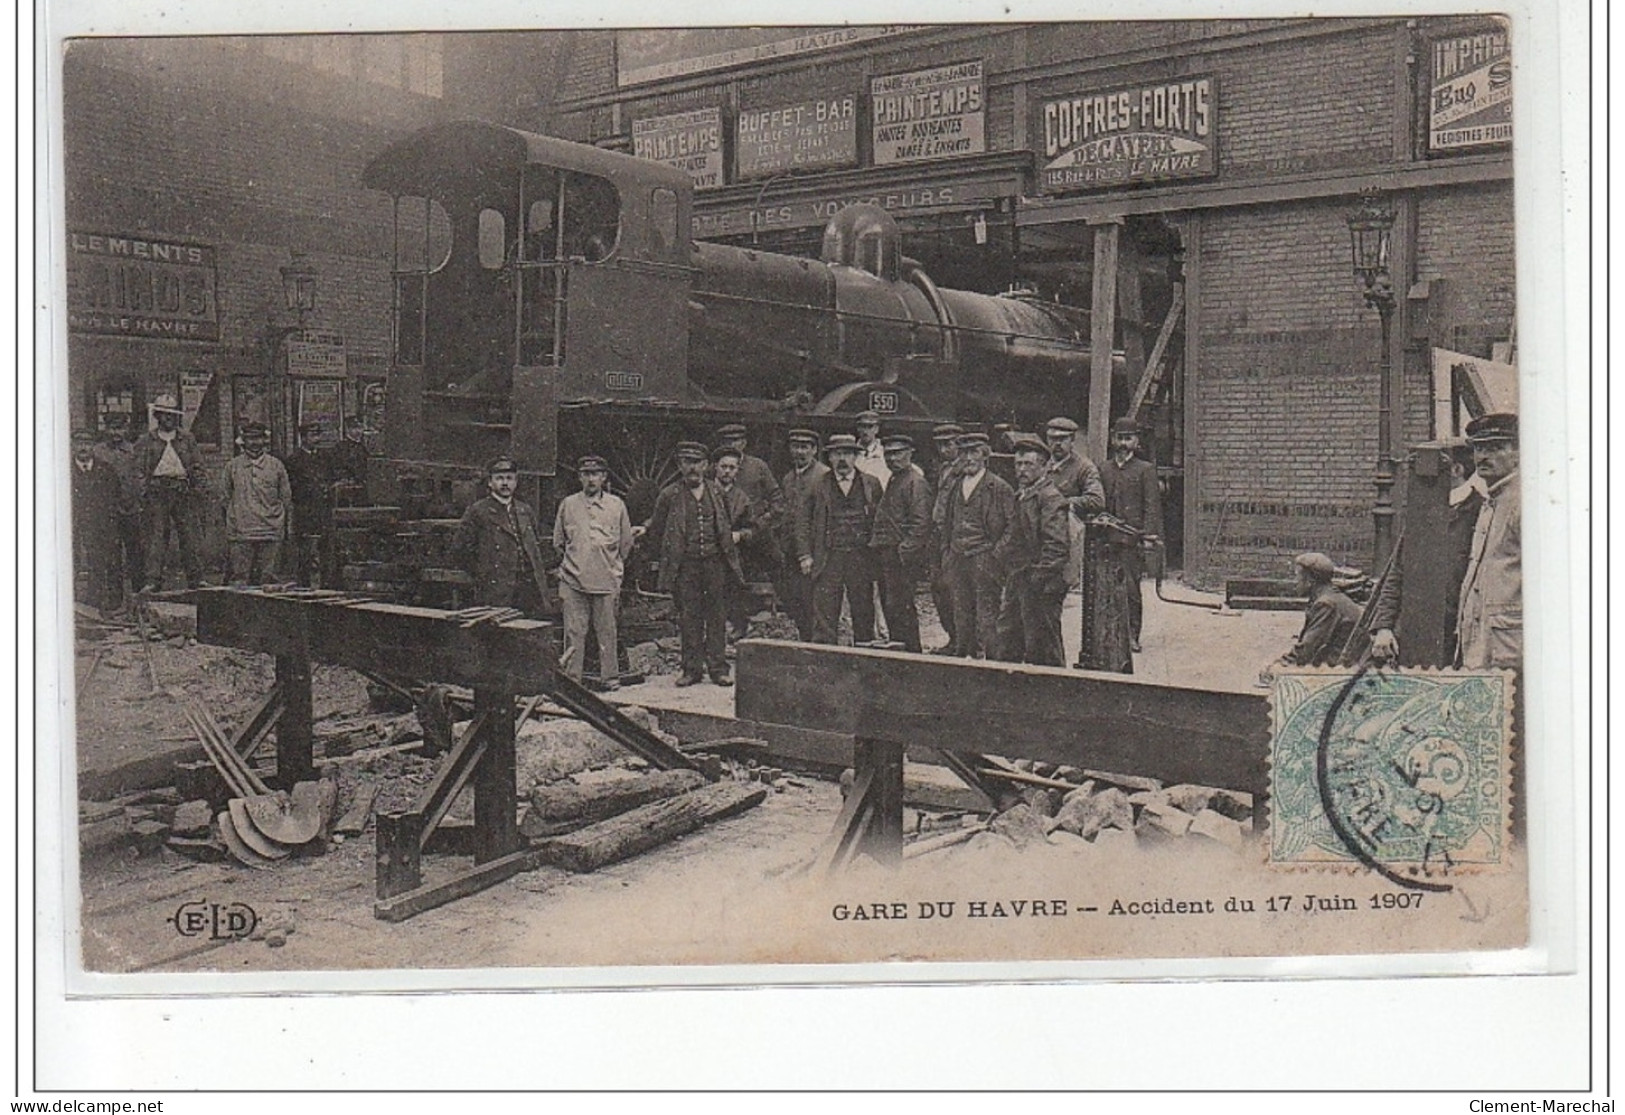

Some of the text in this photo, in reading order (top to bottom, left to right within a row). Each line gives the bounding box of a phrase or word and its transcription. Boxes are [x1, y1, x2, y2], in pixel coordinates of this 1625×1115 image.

[871, 85, 982, 122] PRINTEMPS
[1044, 80, 1210, 157] COFFRES-FORTS
[633, 128, 720, 158] PRINTEMPS
[1130, 161, 1146, 176] LE
[1149, 154, 1201, 172] HAVRE
[750, 207, 792, 226] DES
[874, 394, 894, 410] 550
[833, 893, 1425, 921] GARE DU HAVRE Accident du 17 Juin 1907
